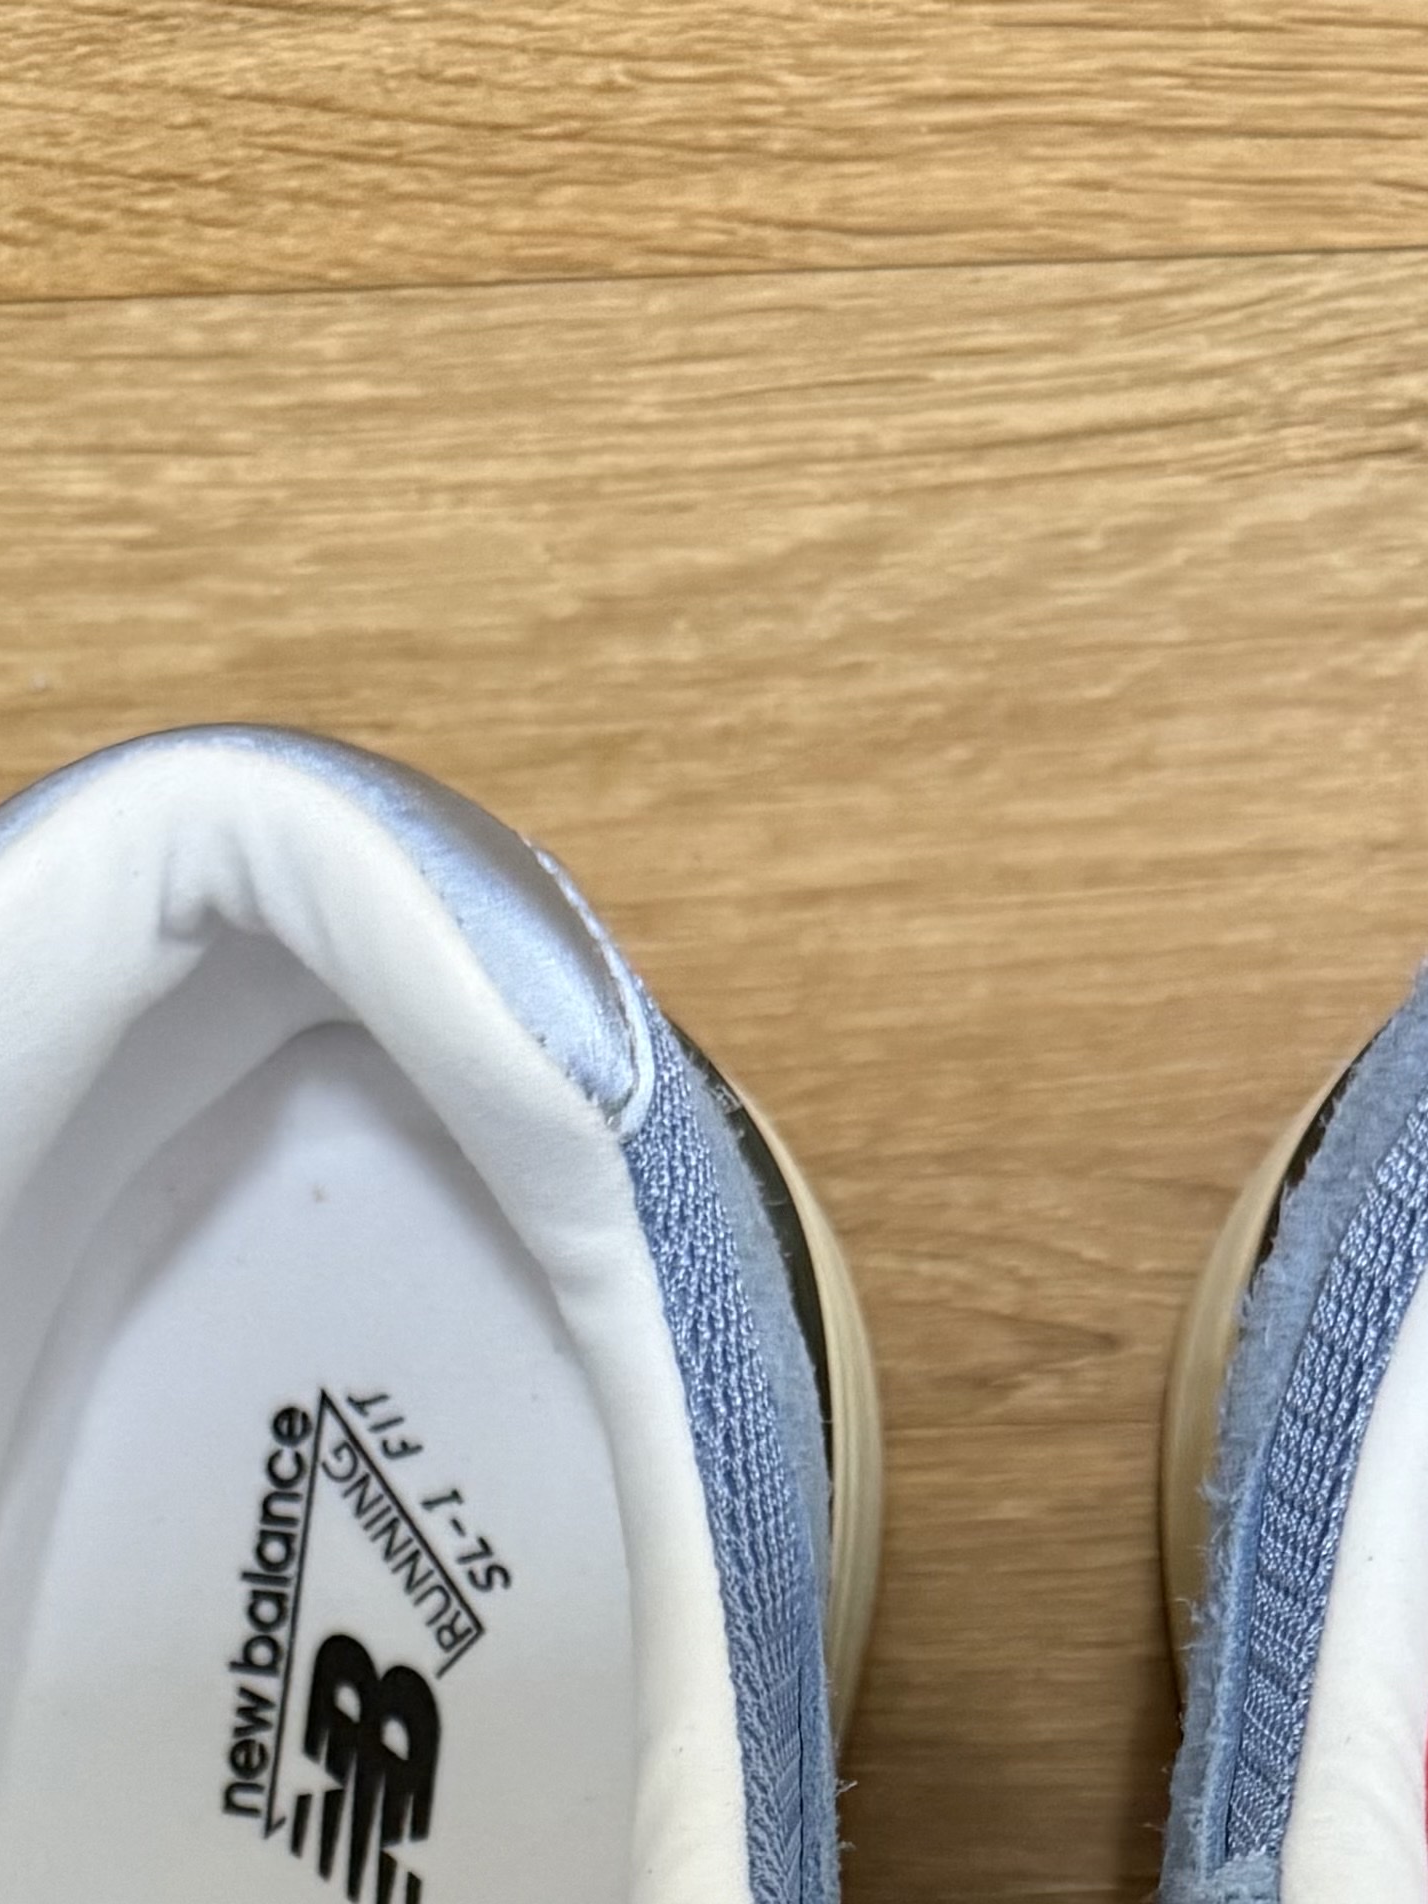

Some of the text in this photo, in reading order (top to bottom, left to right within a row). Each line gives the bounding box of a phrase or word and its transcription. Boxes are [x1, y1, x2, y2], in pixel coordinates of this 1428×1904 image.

[347, 1389, 424, 1462] FIT
[222, 1405, 313, 1818] new balance
[320, 1439, 473, 1653] RUNNING
